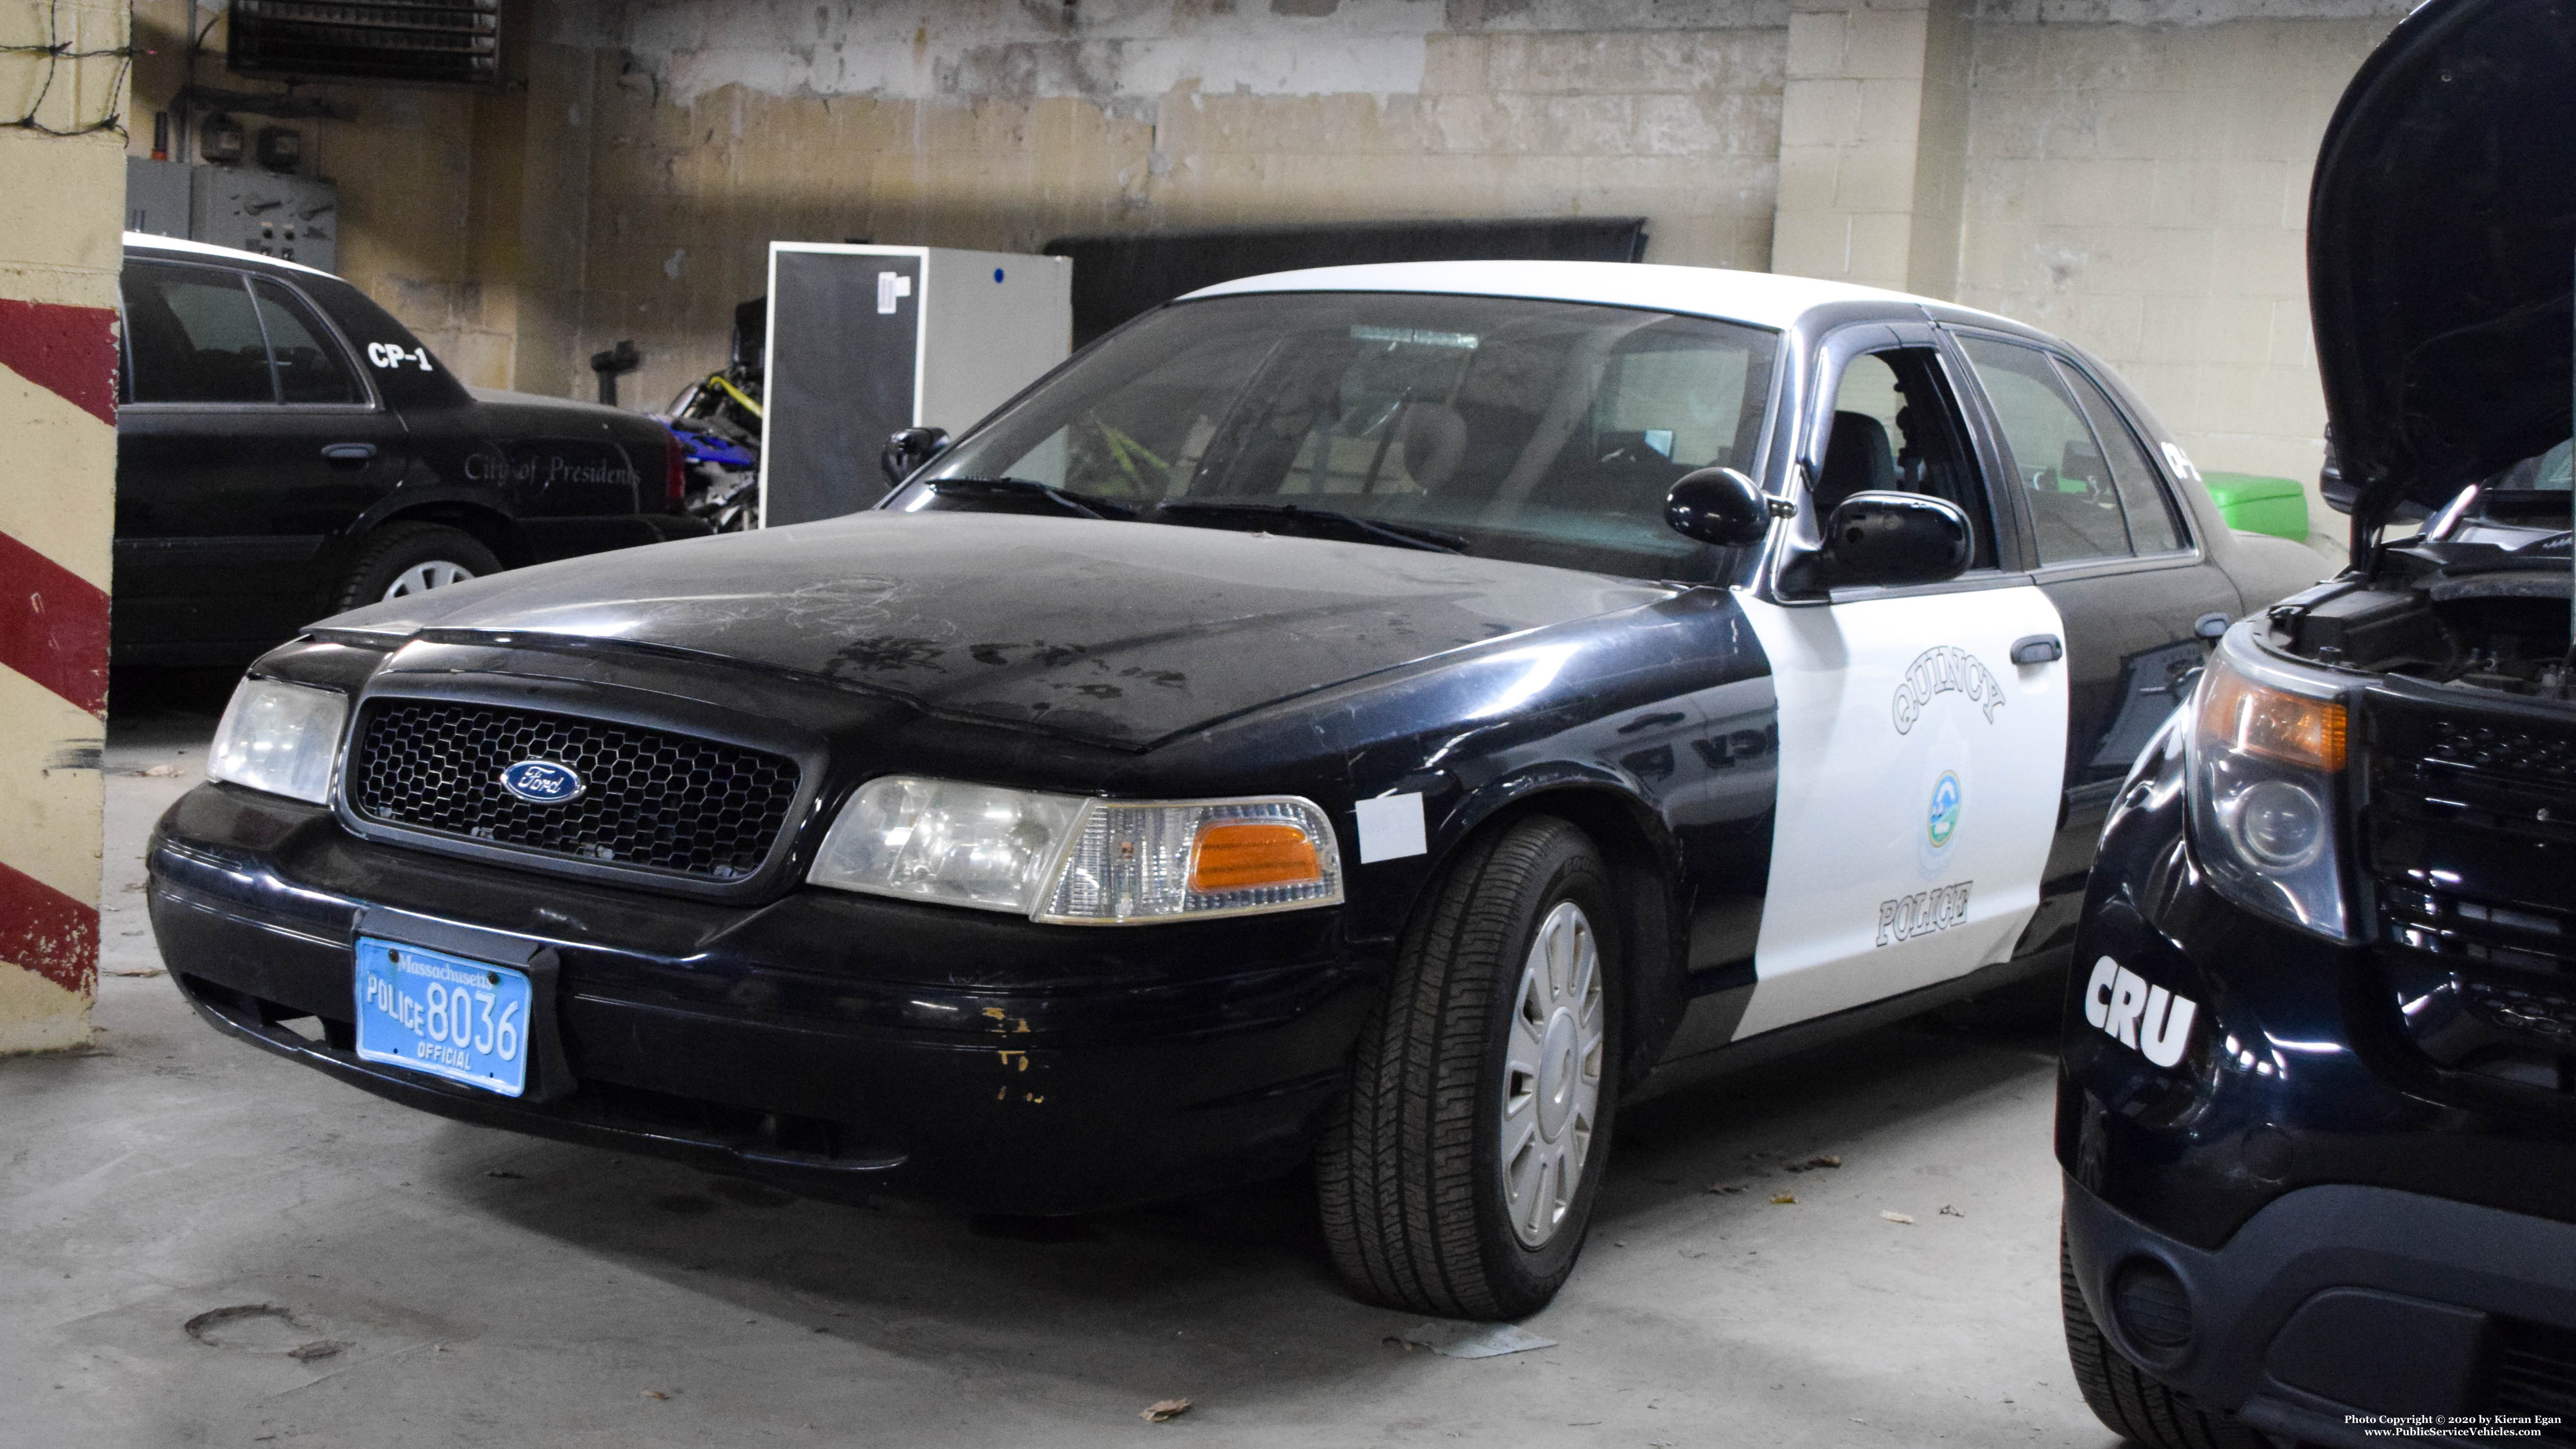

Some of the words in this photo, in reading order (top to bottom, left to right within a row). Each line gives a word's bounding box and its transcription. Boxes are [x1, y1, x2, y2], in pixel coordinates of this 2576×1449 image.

[368, 342, 433, 371] CP-1
[464, 454, 509, 486] City
[514, 456, 539, 485] of
[1892, 645, 2005, 735] QUINCY
[518, 766, 565, 794] Ford
[1876, 880, 1974, 947] POLICE
[397, 953, 492, 990] Massachusetts
[367, 976, 425, 1038] POLICE
[427, 982, 519, 1061] 8036
[2085, 955, 2197, 1067] CRU
[417, 1042, 472, 1071] OFFICIAL
